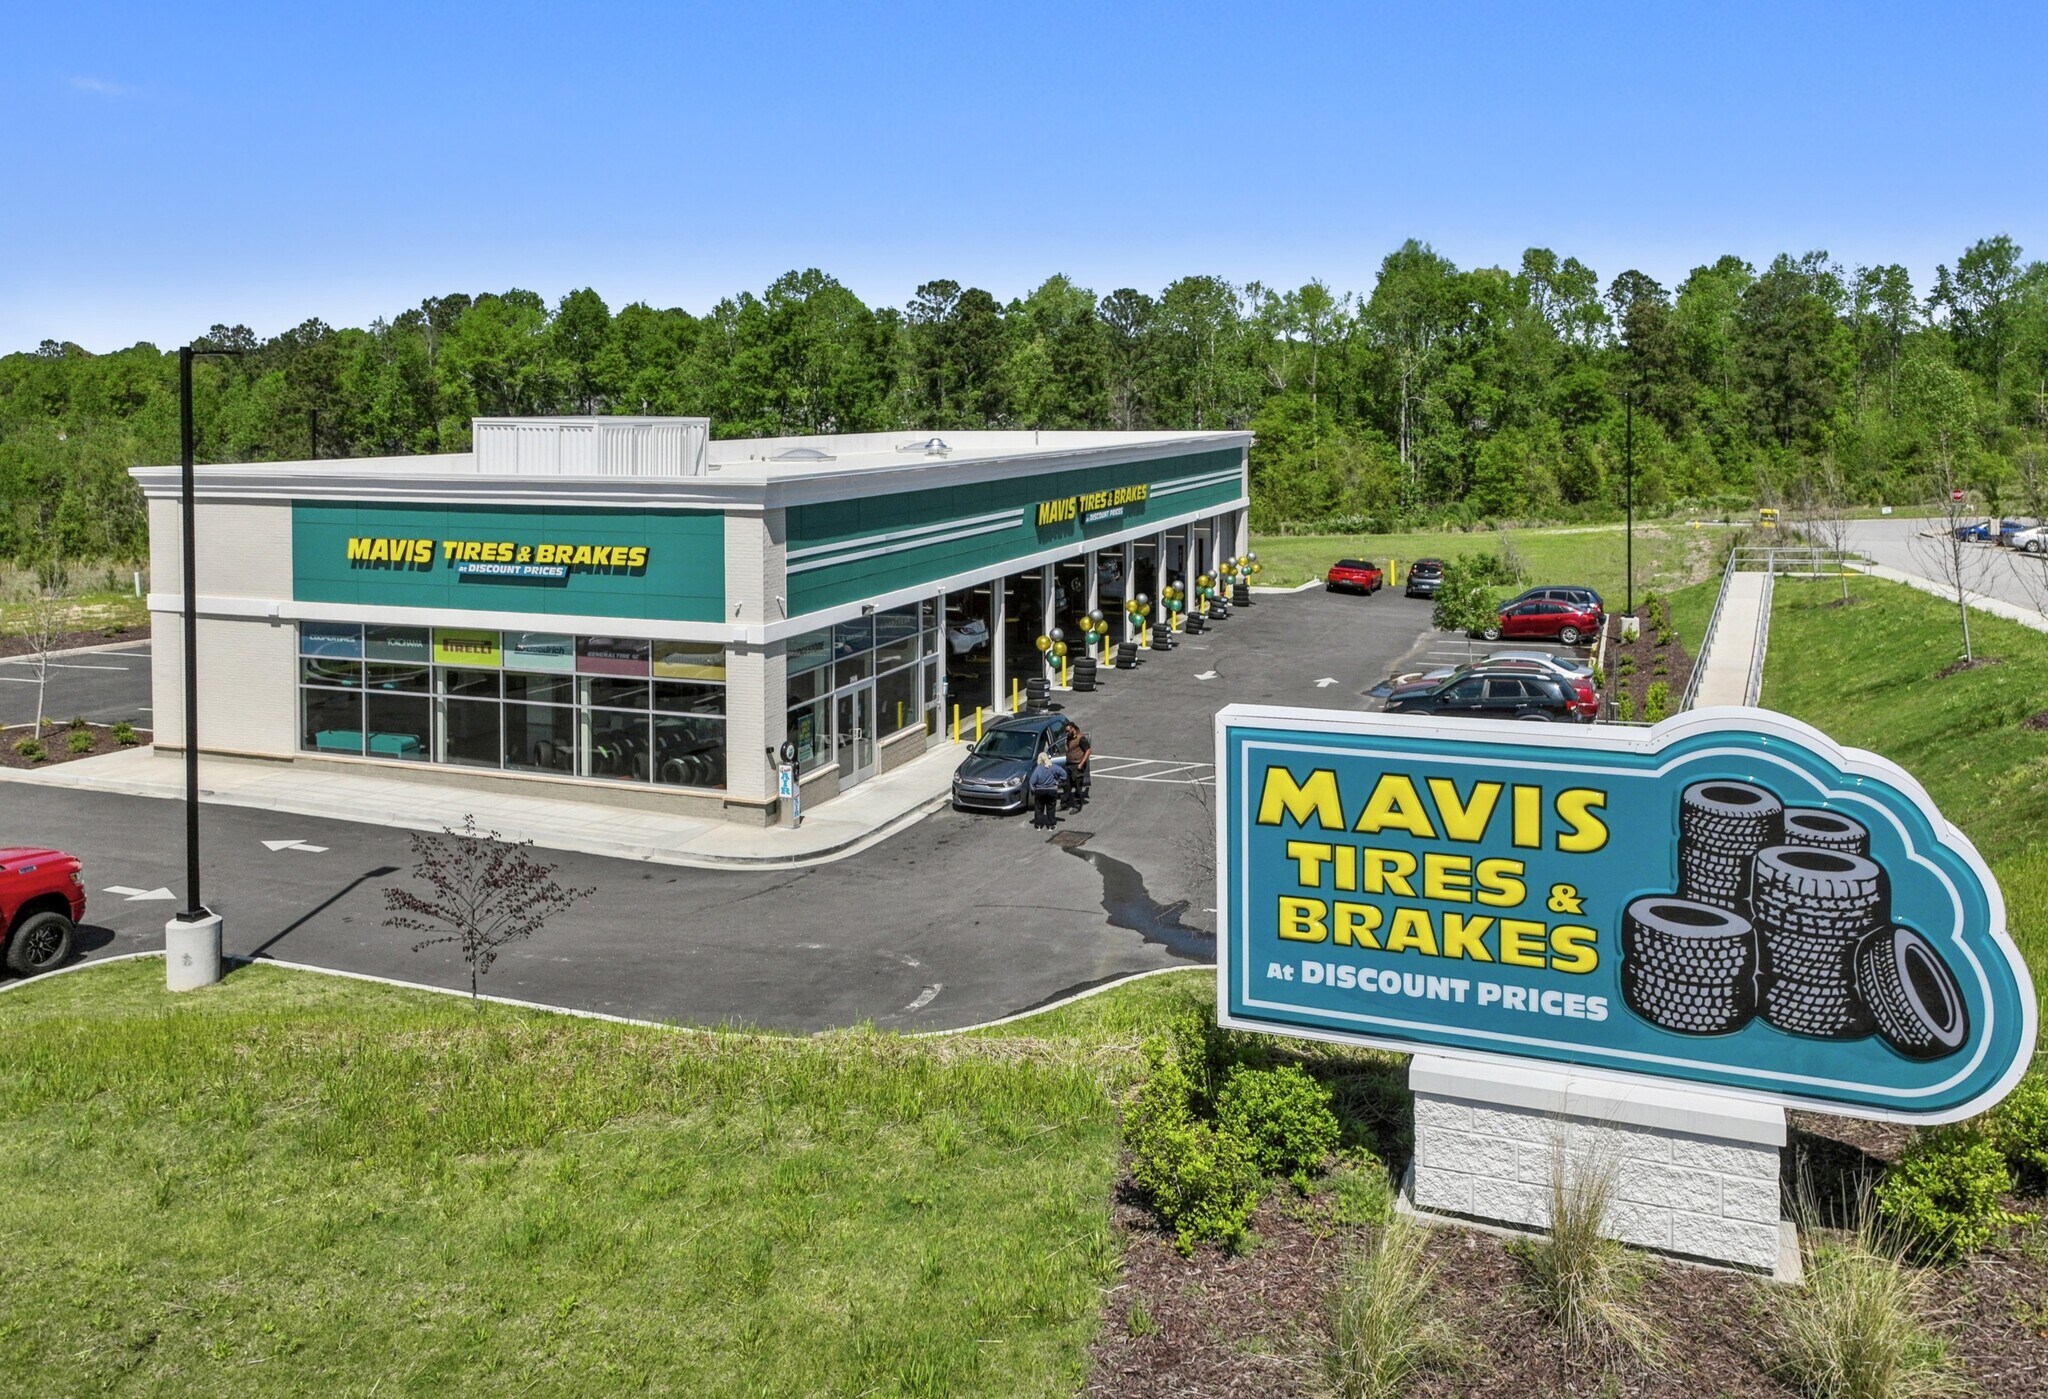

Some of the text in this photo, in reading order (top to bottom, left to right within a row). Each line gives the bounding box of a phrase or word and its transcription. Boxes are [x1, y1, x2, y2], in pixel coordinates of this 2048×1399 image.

[1038, 483, 1148, 526] MAVIS TIRES & BRAKES
[1090, 509, 1110, 521] DISCOUNT
[1110, 507, 1124, 516] PRICES
[347, 537, 648, 567] MAVIS TIRES & BRAKES
[468, 564, 522, 574] DISCOUNT
[523, 566, 565, 577] PRICES
[442, 638, 493, 655] PIRELLI
[781, 772, 791, 795] AIR
[1255, 764, 1610, 854] MAVIS
[1286, 839, 1588, 917] TIRES &
[1277, 894, 1600, 975] BRAKES
[1266, 960, 1609, 1022] At DISCOUNT PRICES
